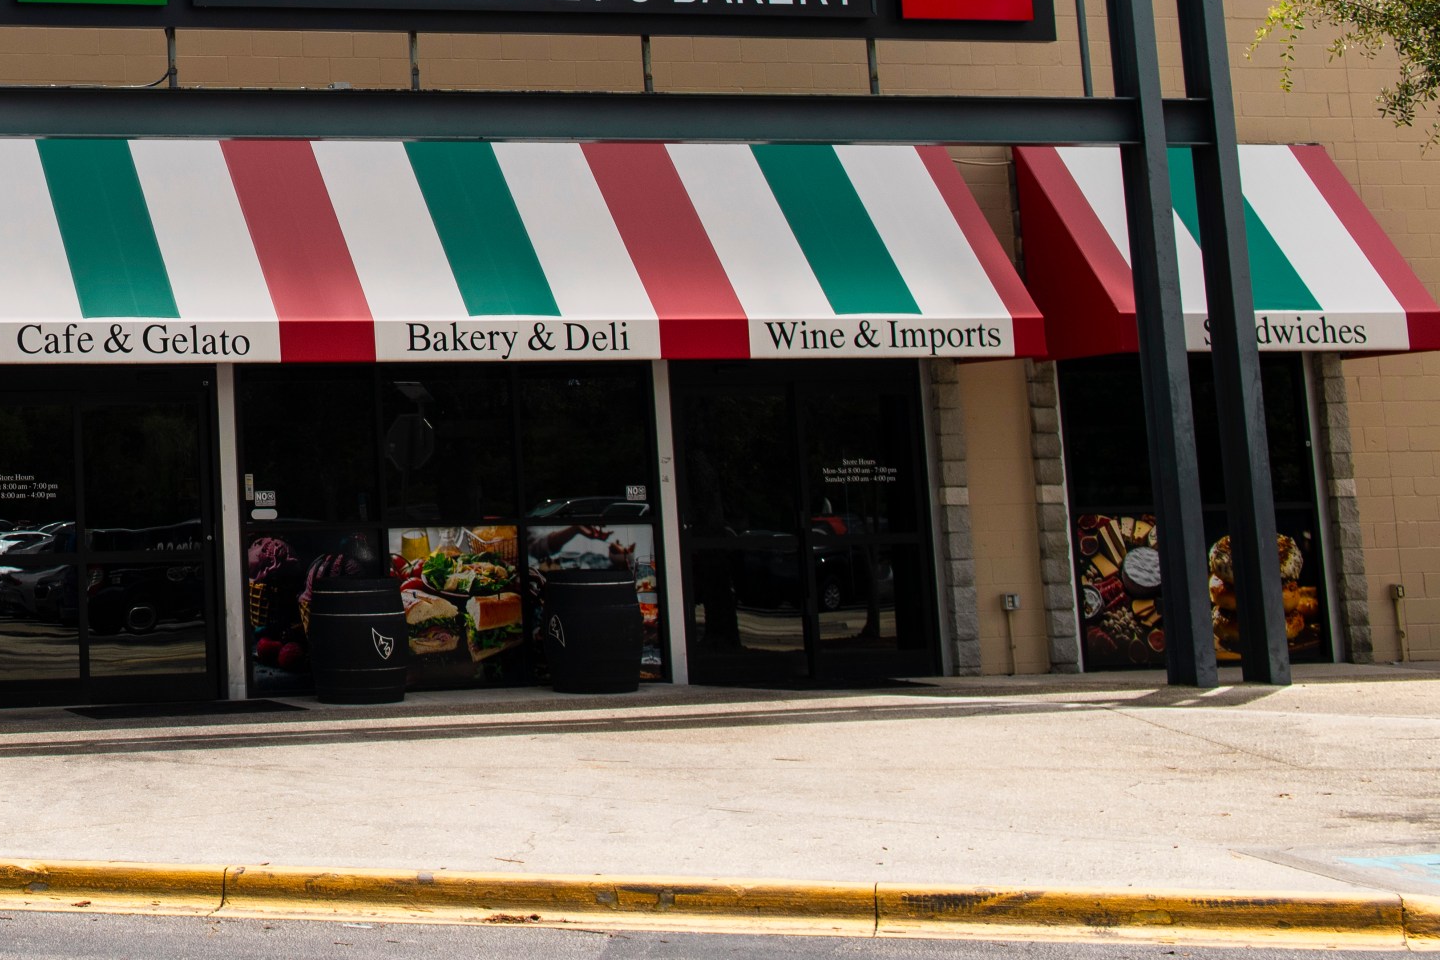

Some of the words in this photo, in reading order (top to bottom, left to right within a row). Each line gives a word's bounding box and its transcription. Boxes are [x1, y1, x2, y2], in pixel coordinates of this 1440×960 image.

[1203, 316, 1368, 346] Sdwiches
[16, 323, 95, 355] Cafe
[103, 323, 134, 354] &
[142, 324, 250, 355] Gelato
[407, 322, 518, 359] Bakery
[527, 322, 556, 351] &
[563, 321, 630, 351] Deli
[764, 320, 846, 350] Wine
[853, 319, 881, 349] &
[887, 320, 1002, 356] Imports
[15, 473, 35, 481] Hours
[33, 482, 47, 490] 7:00
[47, 483, 59, 491] pm
[627, 487, 638, 495] NO
[46, 492, 56, 500] pm
[256, 492, 267, 501] NO
